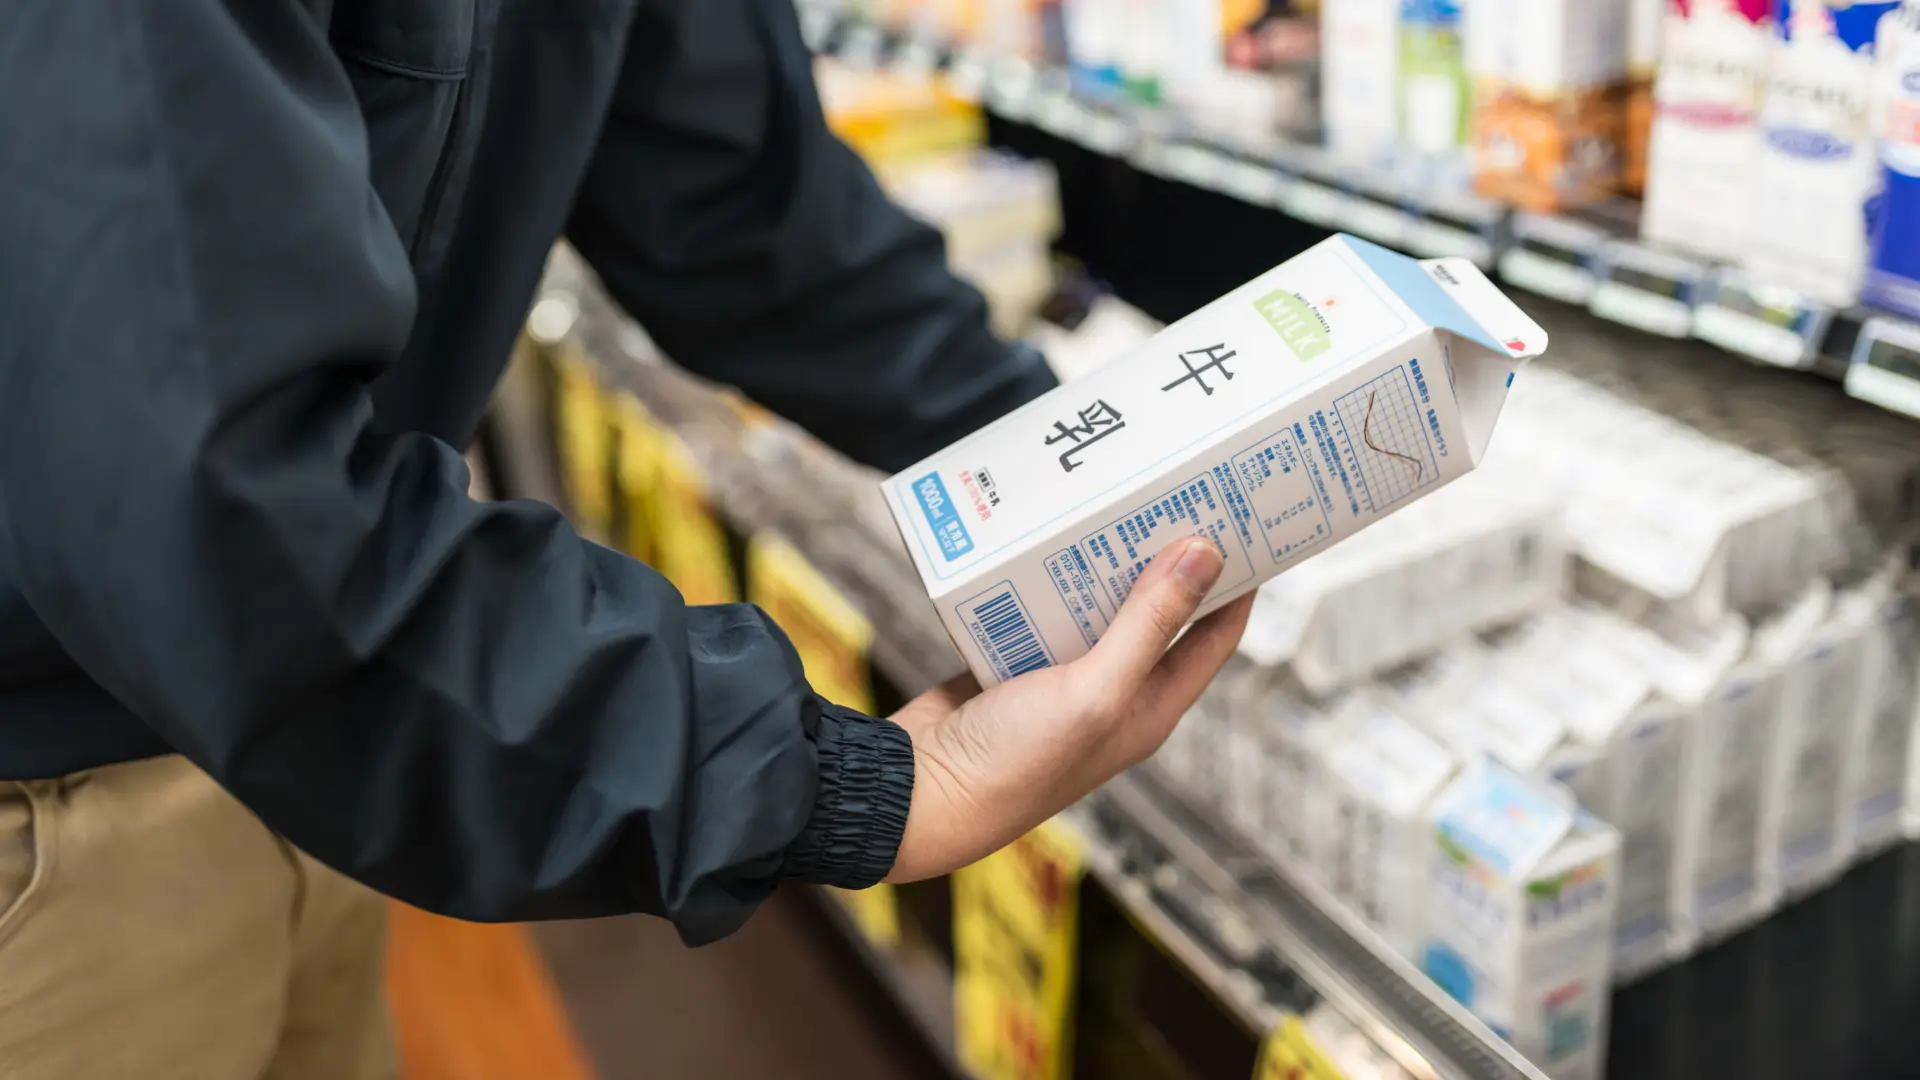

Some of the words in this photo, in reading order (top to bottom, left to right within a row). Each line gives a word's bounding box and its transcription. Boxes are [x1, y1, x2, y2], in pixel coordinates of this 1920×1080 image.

[1262, 296, 1318, 354] MILK
[1310, 307, 1331, 334] Products
[1044, 342, 1237, 473] 牛乳
[1273, 444, 1291, 473] タンパク質
[1281, 439, 1297, 467] エネルギー
[1239, 462, 1256, 492] カルシウム
[1248, 457, 1264, 487] ナトリウム
[920, 478, 944, 519] 1000ml
[989, 491, 1000, 507] 牛乳
[1144, 510, 1157, 528] 内容量
